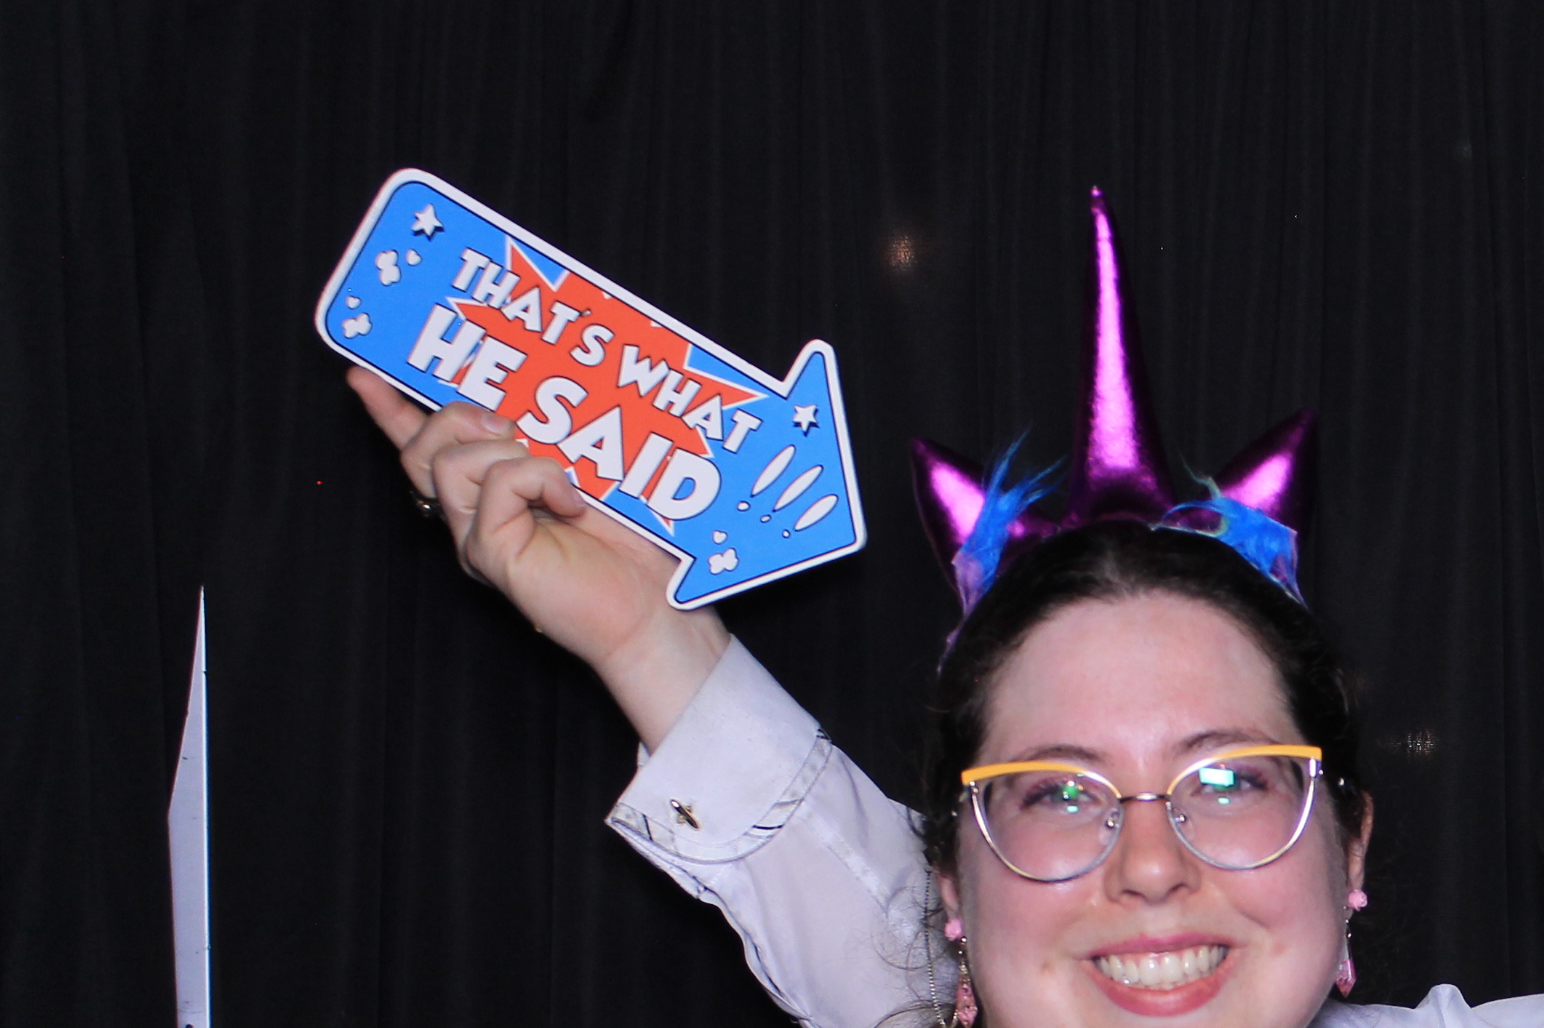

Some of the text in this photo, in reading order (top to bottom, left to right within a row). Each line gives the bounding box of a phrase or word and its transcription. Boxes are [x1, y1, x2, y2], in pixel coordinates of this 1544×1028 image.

[406, 304, 722, 521] HE SAID
[453, 247, 763, 453] THAT'S WHAT
